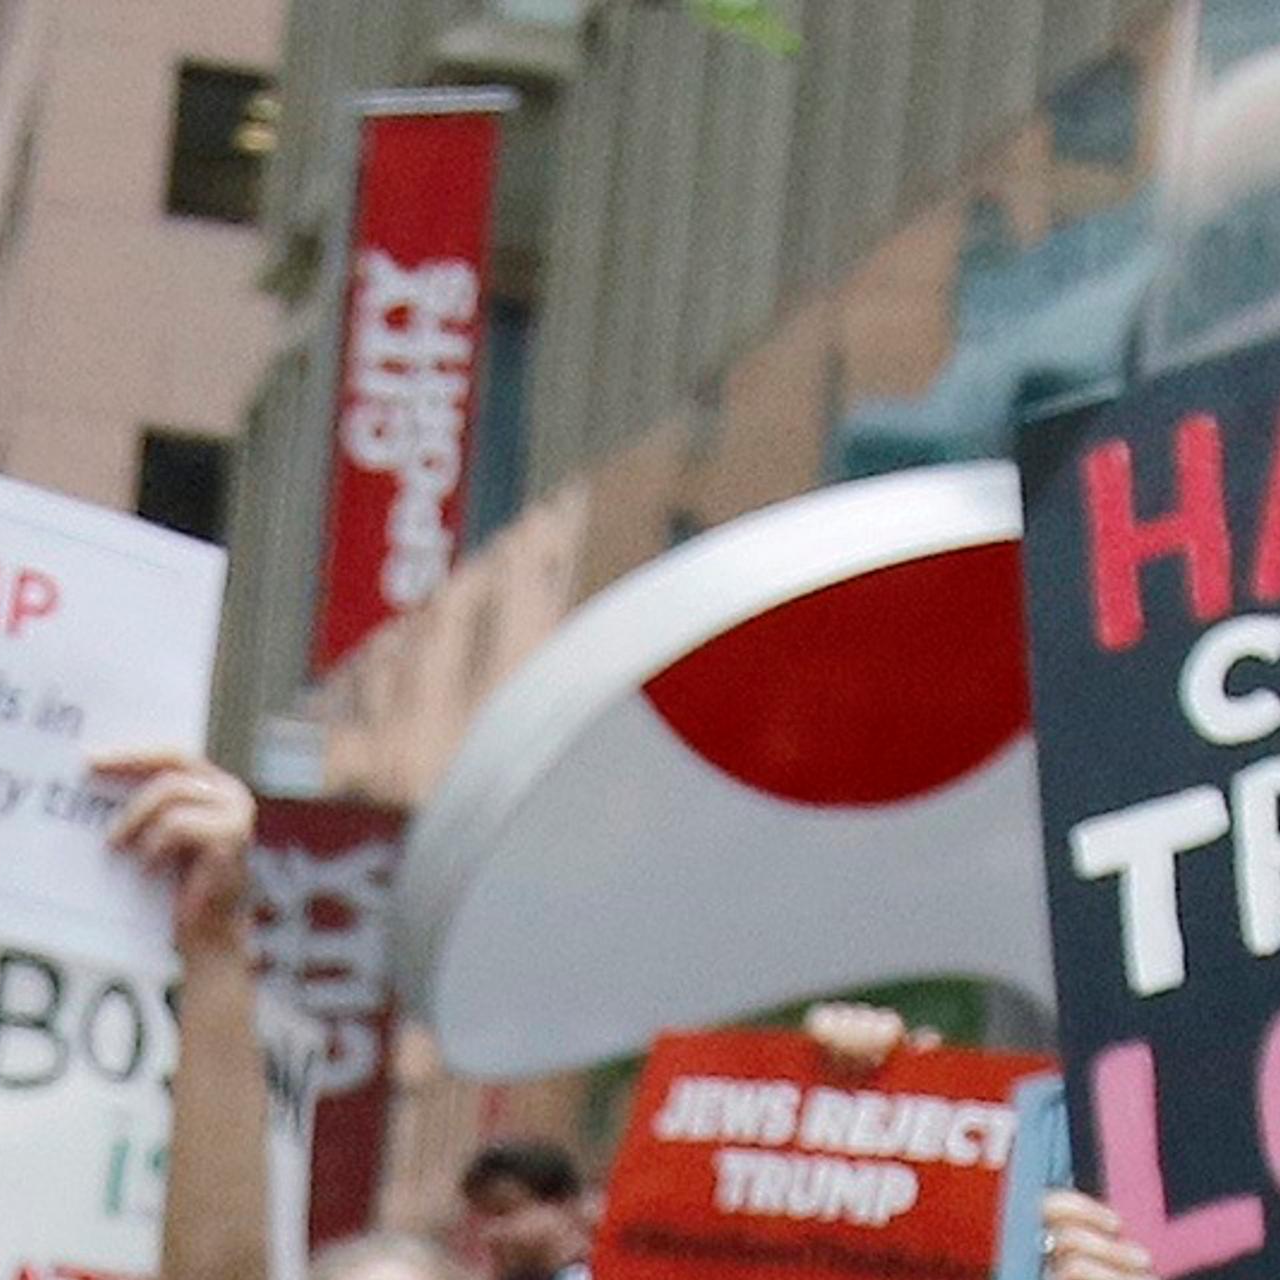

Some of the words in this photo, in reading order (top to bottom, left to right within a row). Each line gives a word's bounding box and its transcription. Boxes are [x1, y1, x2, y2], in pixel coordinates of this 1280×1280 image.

[32, 688, 87, 738] in
[652, 1075, 802, 1145] JEWS
[799, 1085, 1017, 1171] REJECT
[713, 1145, 920, 1228] TRUMP
